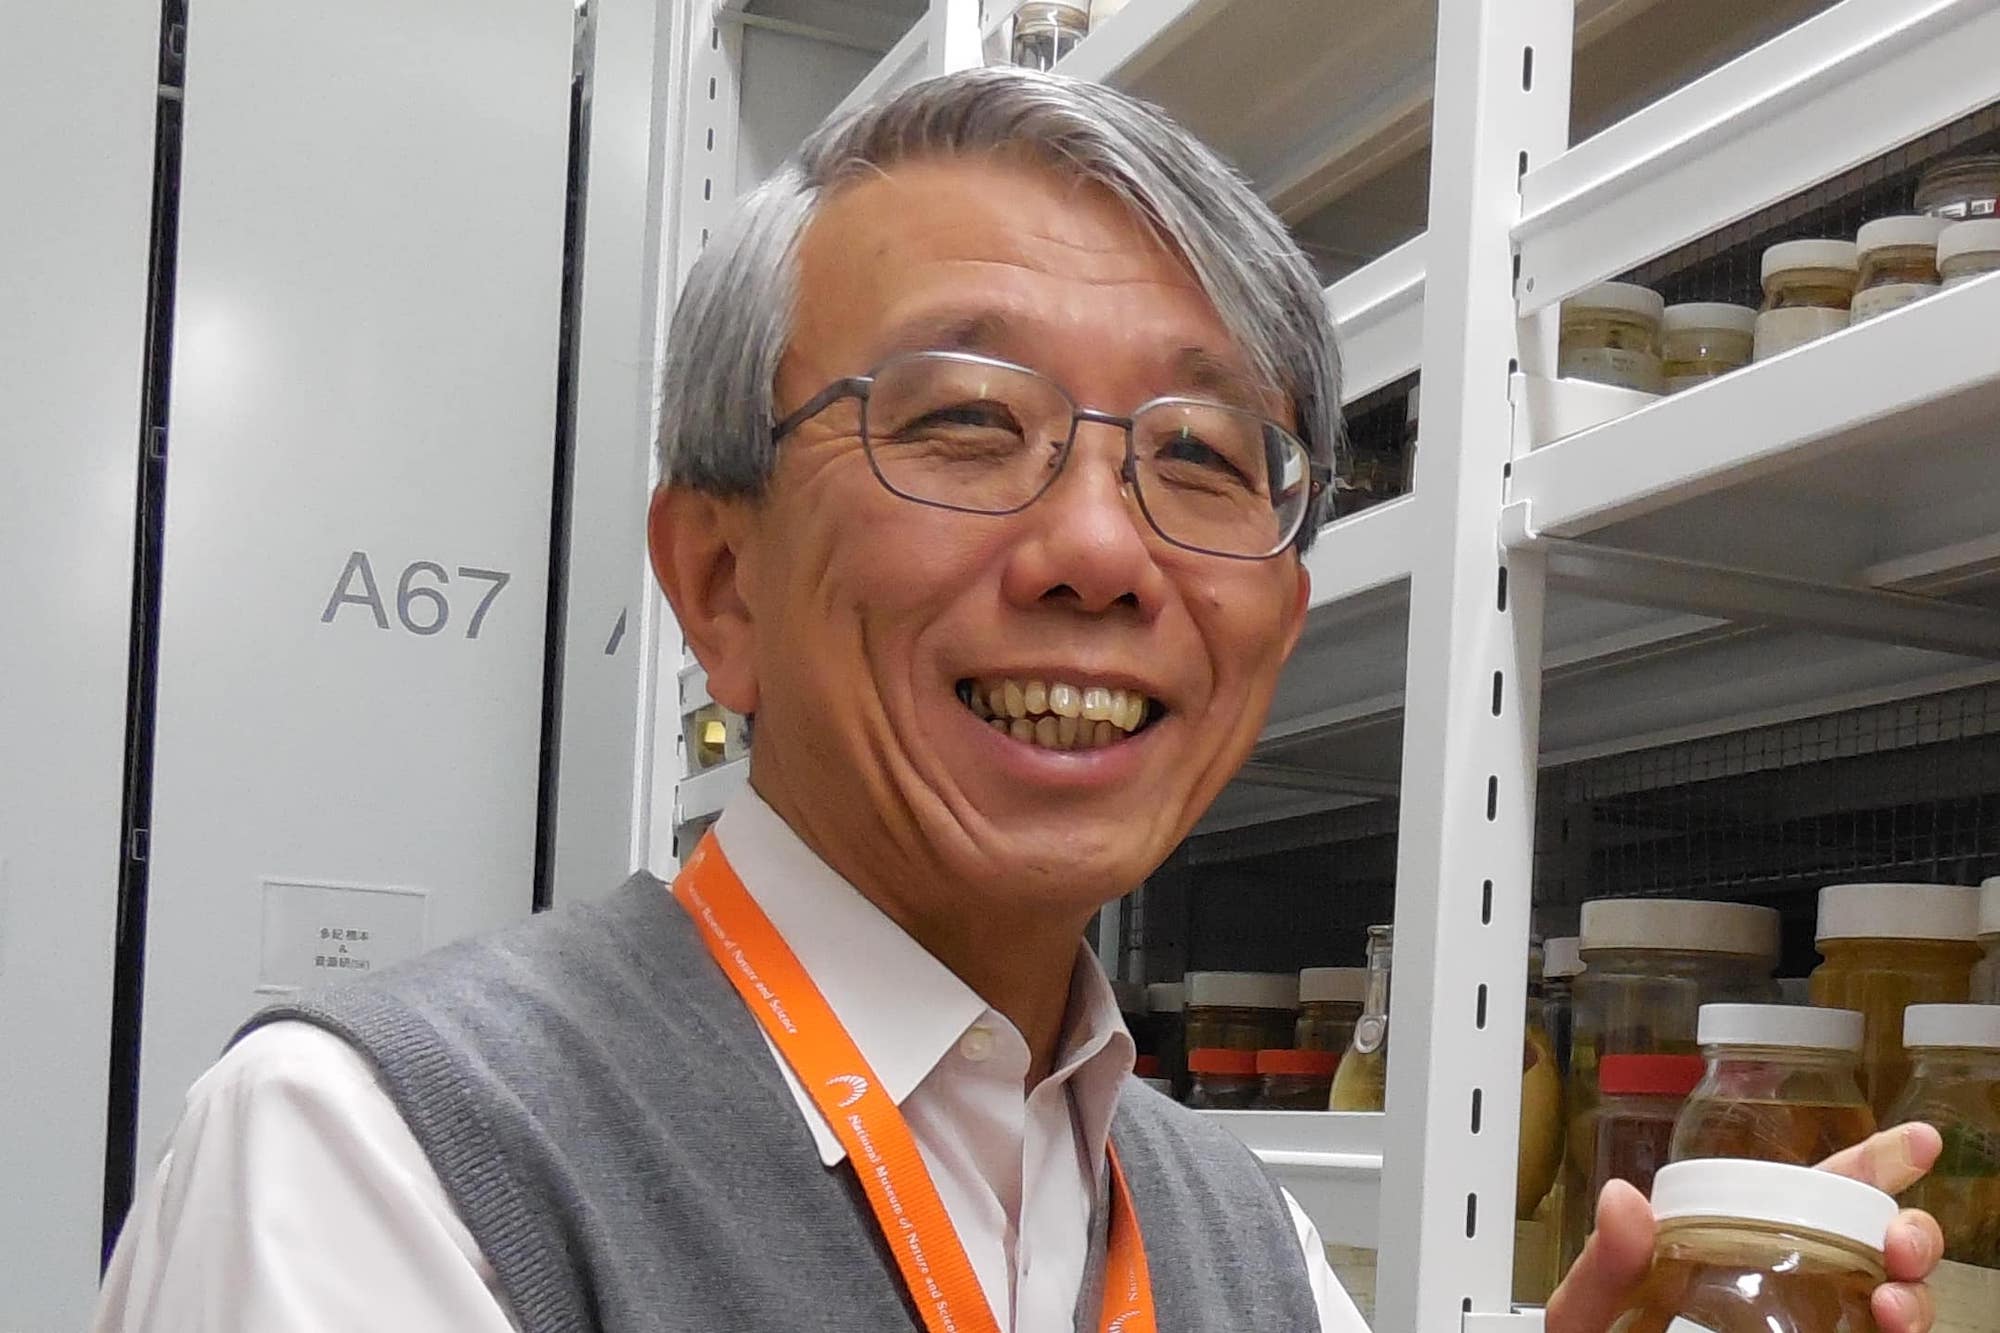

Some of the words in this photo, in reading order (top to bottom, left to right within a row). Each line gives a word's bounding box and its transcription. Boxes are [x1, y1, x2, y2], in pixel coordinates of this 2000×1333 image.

[321, 551, 511, 639] A67
[756, 982, 774, 999] and
[769, 1000, 798, 1034] Science
[848, 1114, 881, 1164] National
[875, 1165, 904, 1215] Museum
[899, 1217, 914, 1231] of
[907, 1232, 930, 1274] Nature
[925, 1278, 943, 1299] and
